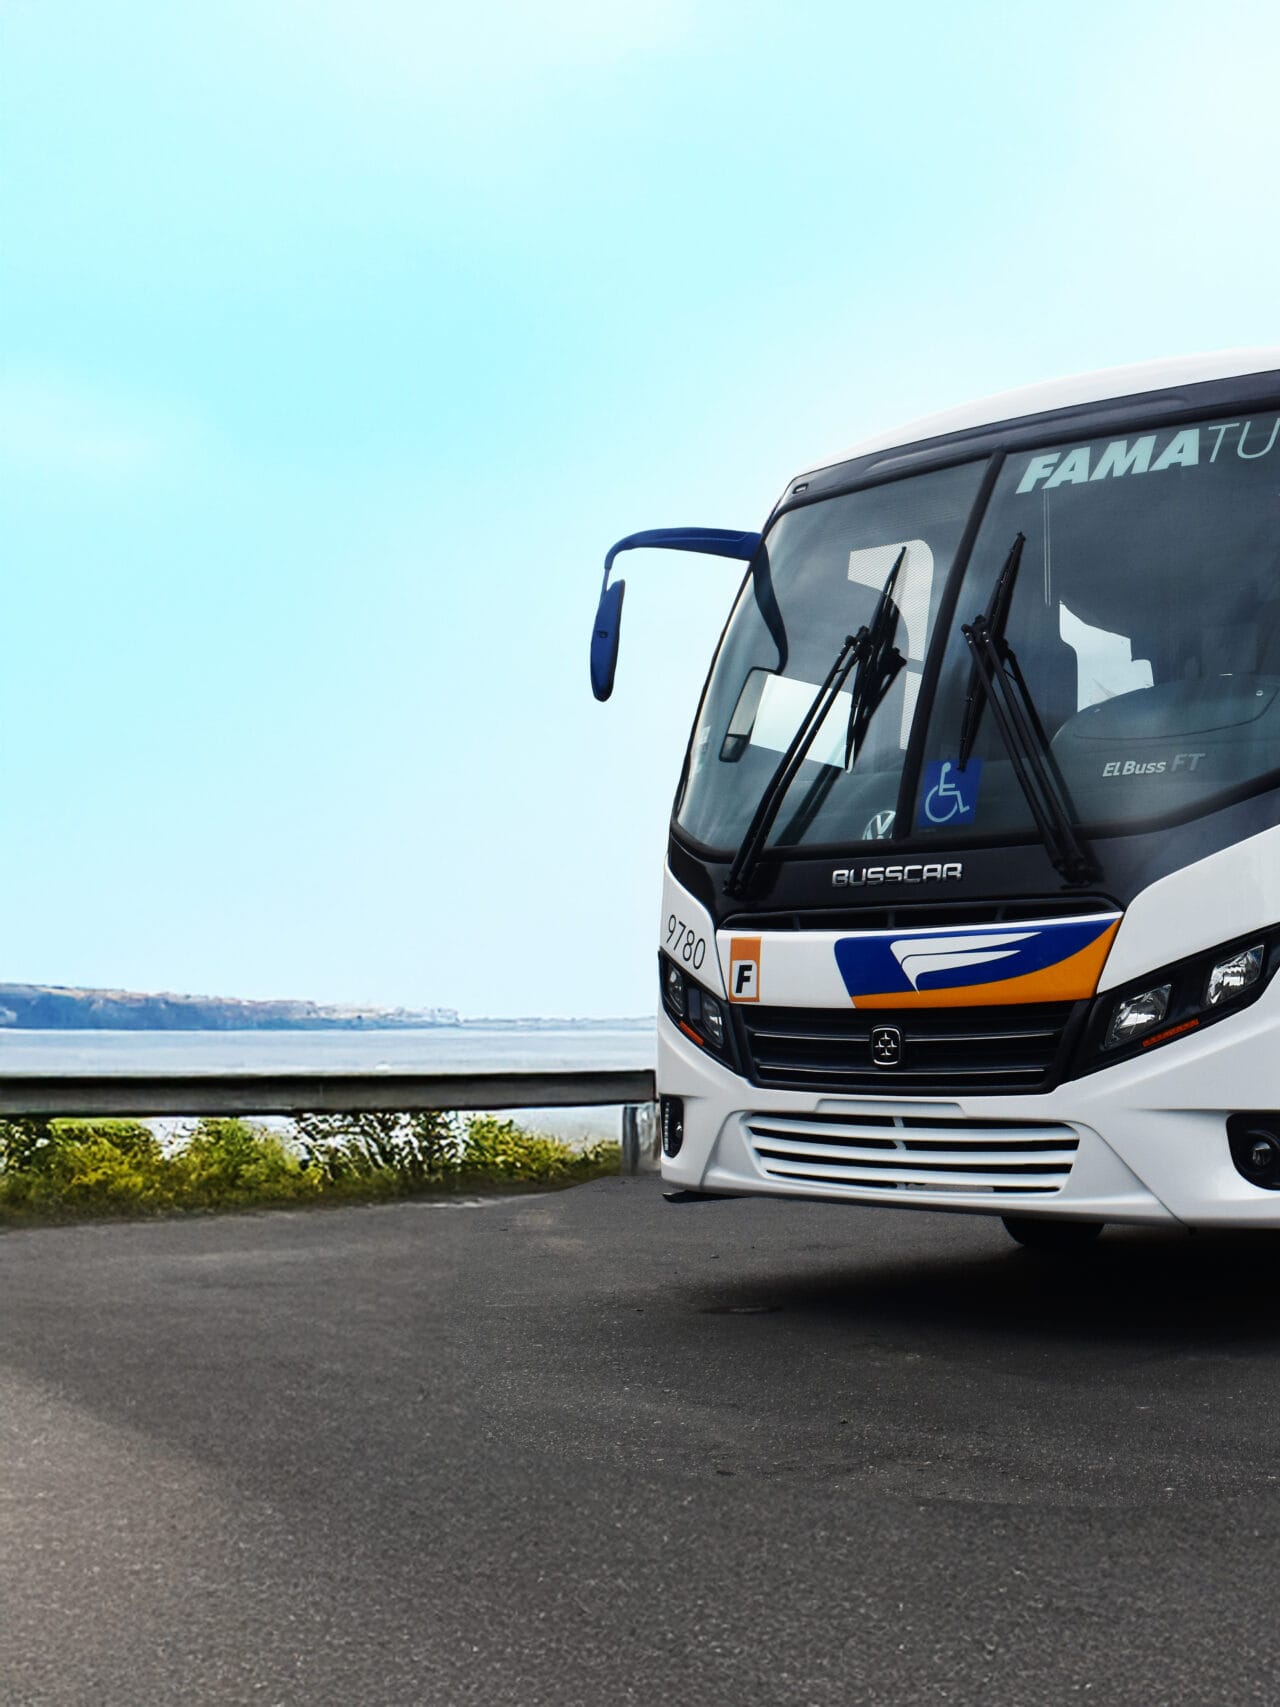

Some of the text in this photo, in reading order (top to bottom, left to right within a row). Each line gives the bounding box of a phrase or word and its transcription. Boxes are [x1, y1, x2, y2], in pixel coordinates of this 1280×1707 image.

[1171, 753, 1206, 772] FT
[832, 862, 963, 887] BUSSCAR
[666, 914, 706, 970] 9780
[735, 964, 753, 994] F
